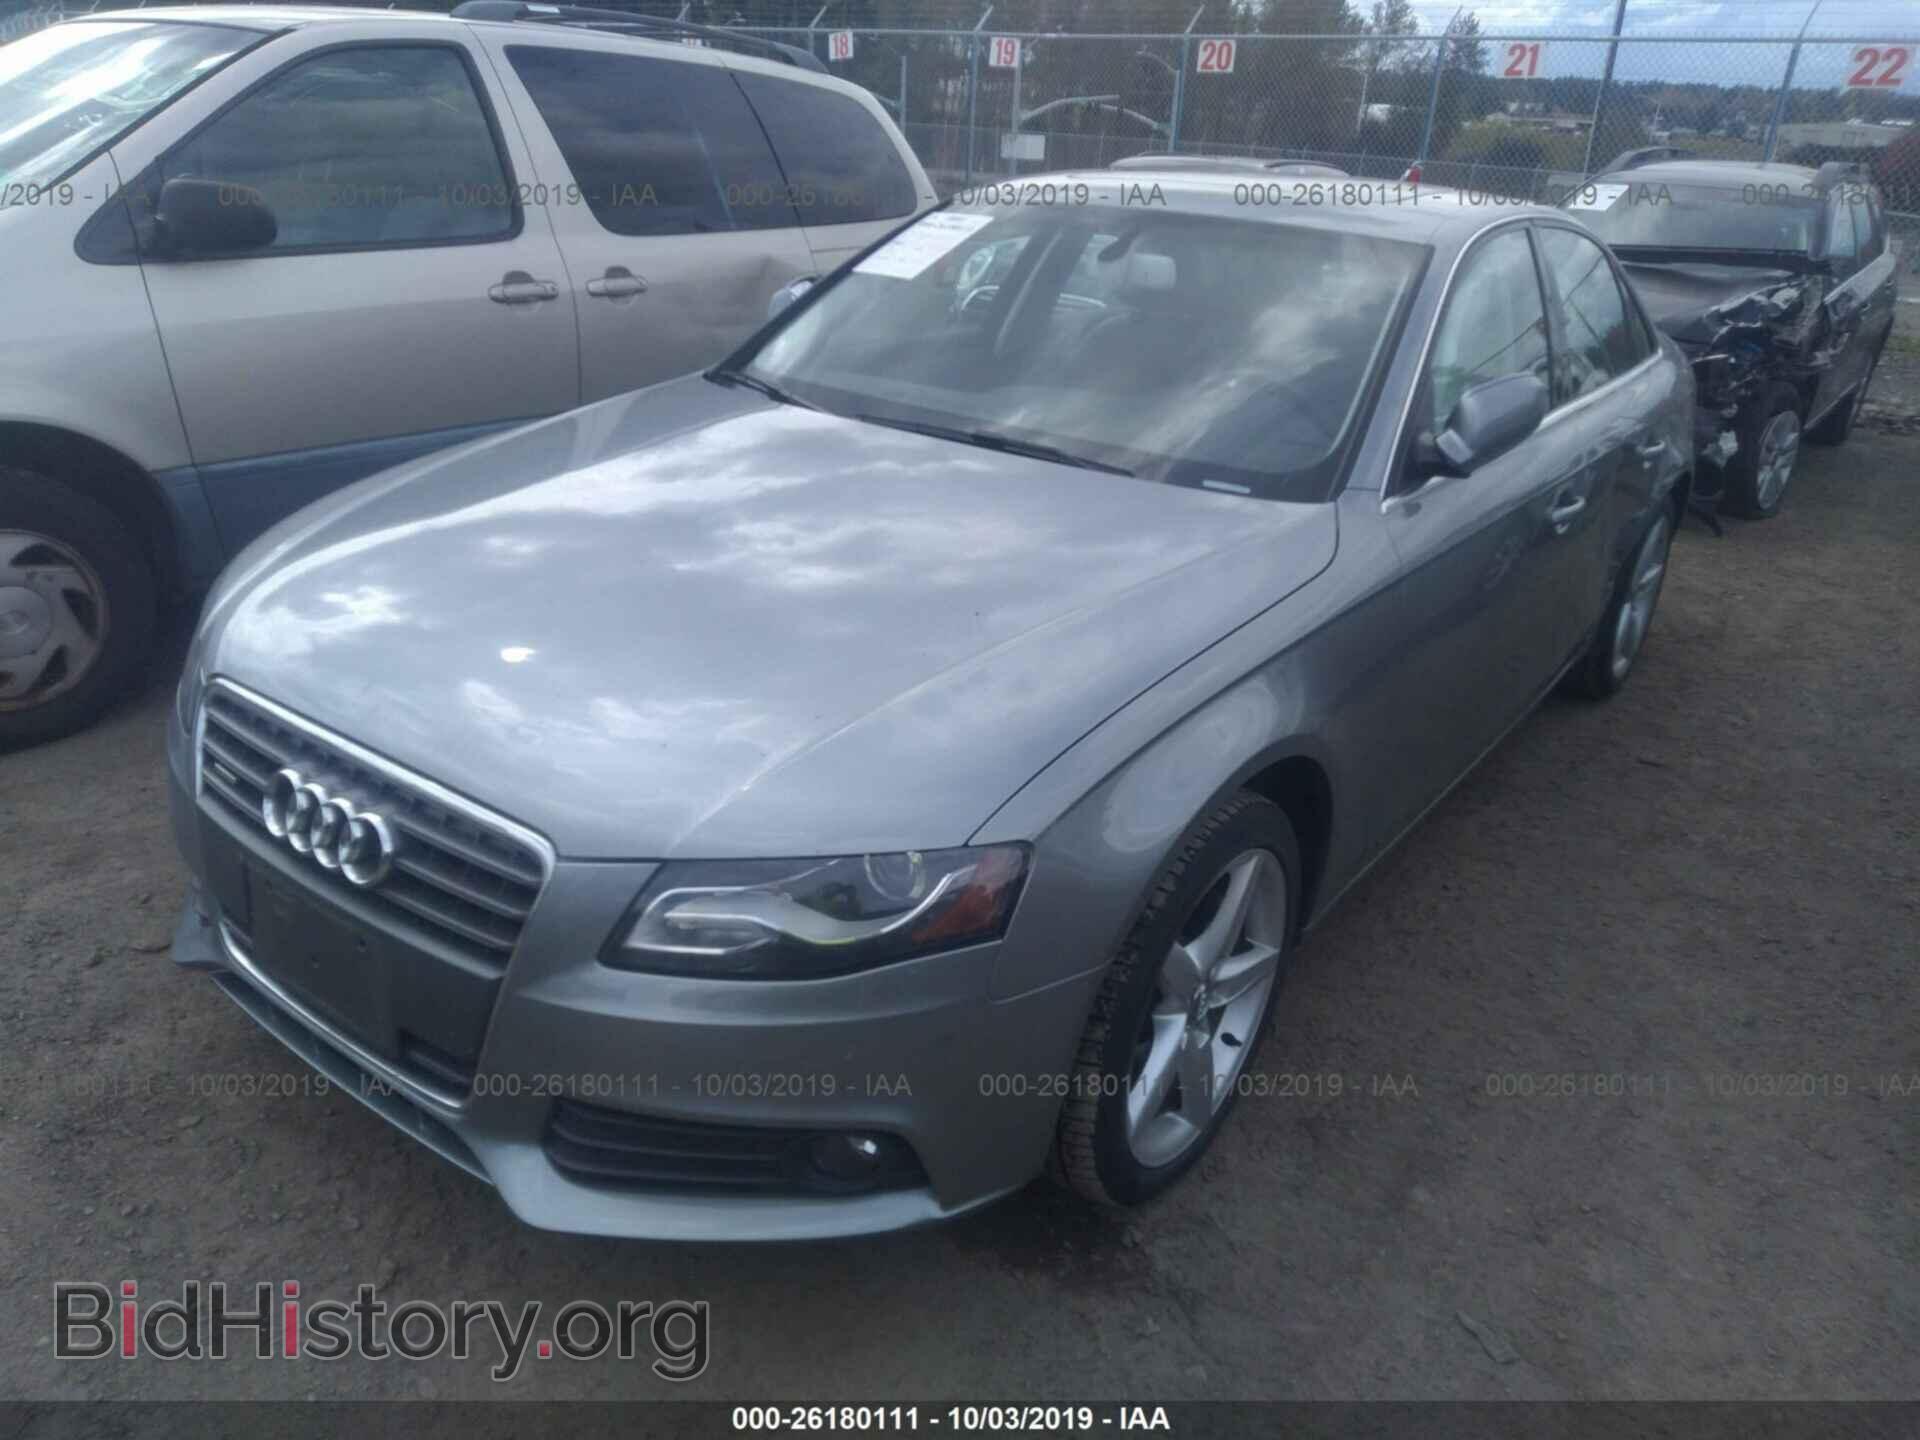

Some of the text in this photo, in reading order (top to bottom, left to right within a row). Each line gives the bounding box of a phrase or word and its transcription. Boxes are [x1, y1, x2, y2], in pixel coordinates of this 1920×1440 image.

[832, 33, 849, 57] 18
[995, 37, 1016, 65] 19
[1200, 41, 1232, 70] 20
[1503, 43, 1541, 77] 21
[1847, 48, 1906, 86] 22
